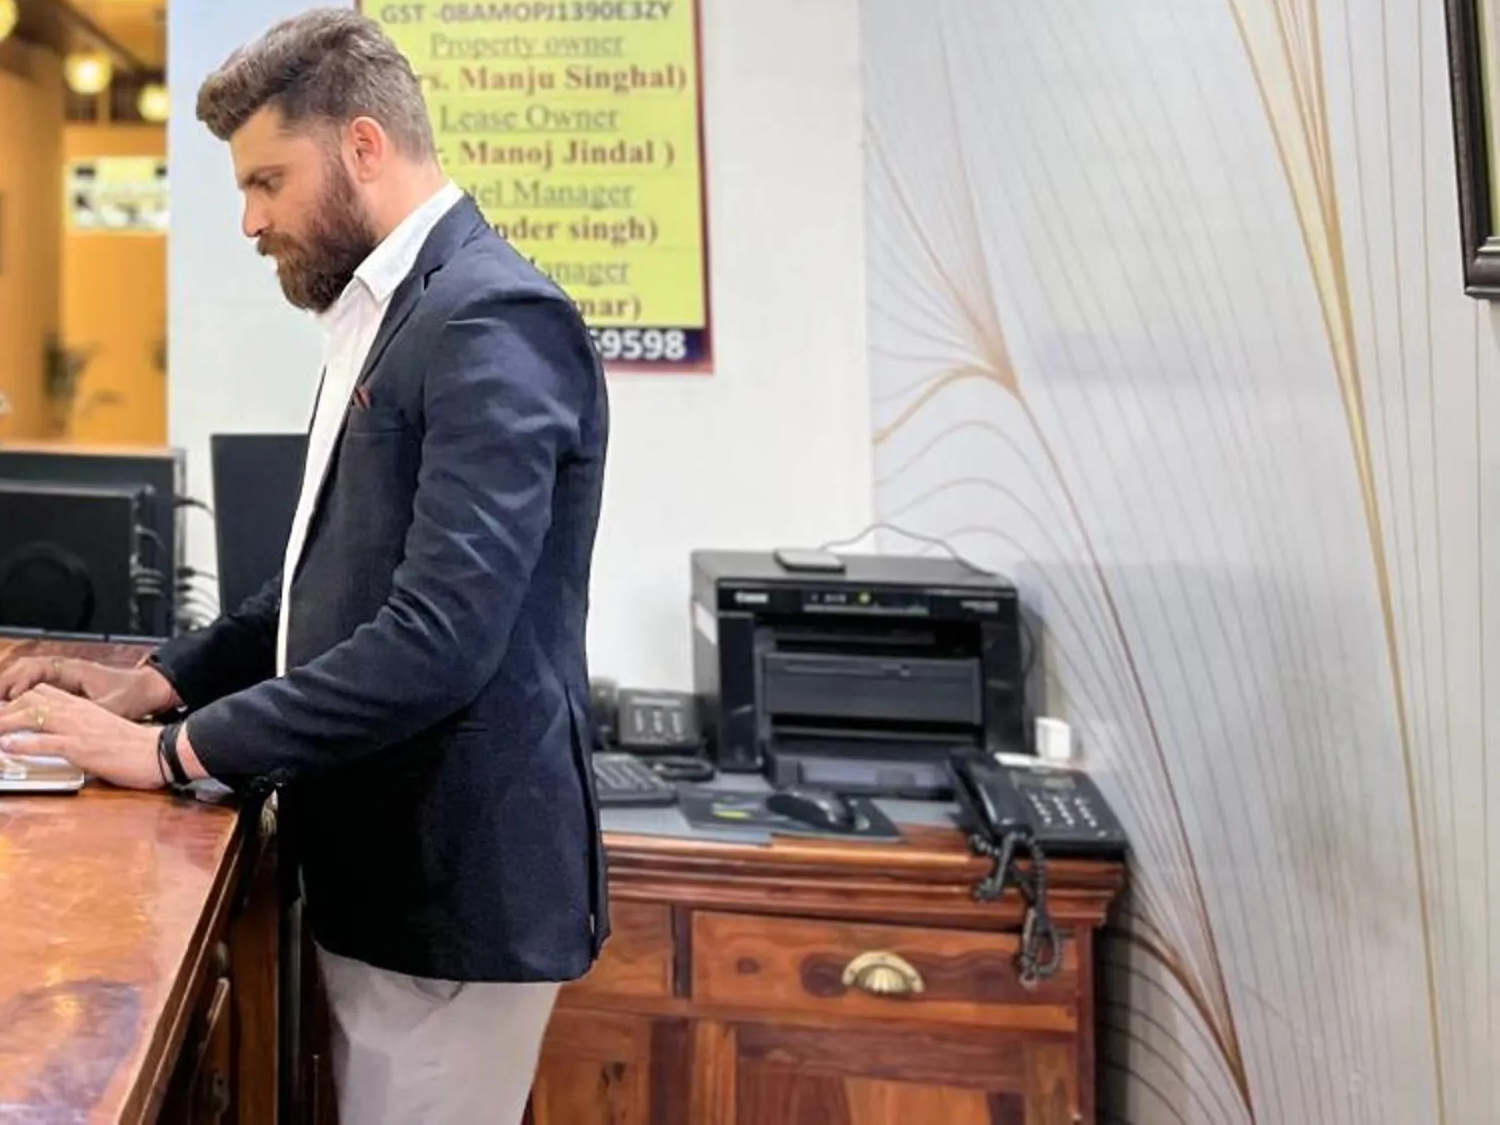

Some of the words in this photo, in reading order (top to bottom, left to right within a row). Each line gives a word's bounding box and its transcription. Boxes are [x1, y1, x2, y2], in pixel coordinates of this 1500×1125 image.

[380, 4, 425, 25] GST
[430, 32, 537, 59] Property
[545, 35, 625, 56] owner
[459, 65, 556, 97] Manju
[563, 63, 688, 95] Singhal)
[440, 104, 518, 132] Lease
[524, 103, 620, 132] Owner
[459, 140, 554, 172] Manoj
[560, 138, 655, 166] Jindal
[512, 178, 636, 210] Manager
[569, 215, 659, 245] singh)
